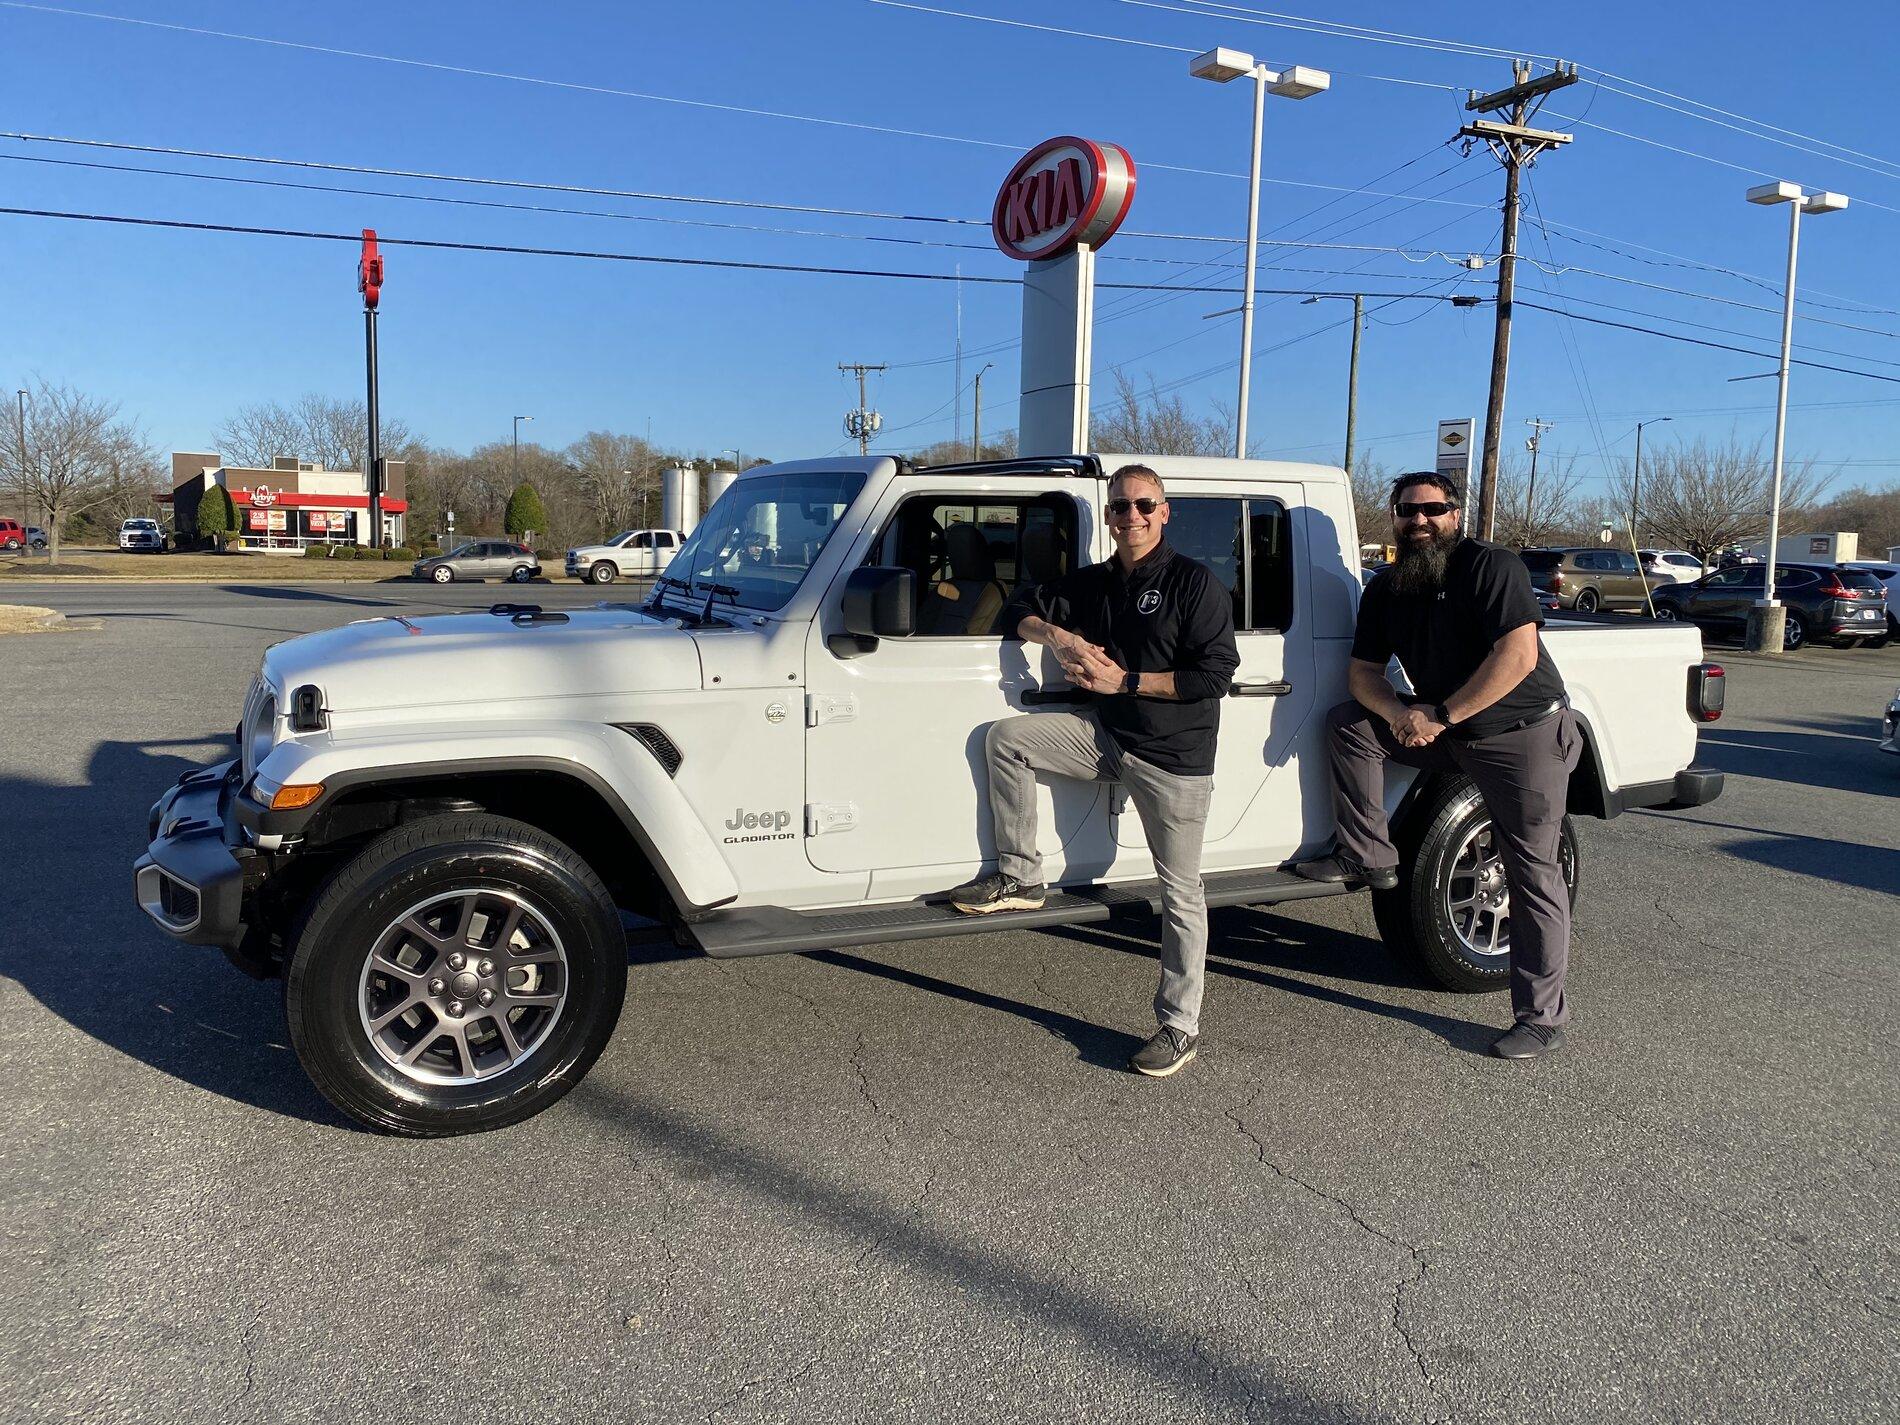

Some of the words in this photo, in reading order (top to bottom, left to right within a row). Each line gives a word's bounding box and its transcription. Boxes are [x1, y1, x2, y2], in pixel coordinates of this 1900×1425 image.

[1009, 158, 1084, 242] KIA
[250, 493, 276, 503] Arby's
[725, 808, 791, 831] Jeep
[723, 833, 795, 844] GLADIATOR
